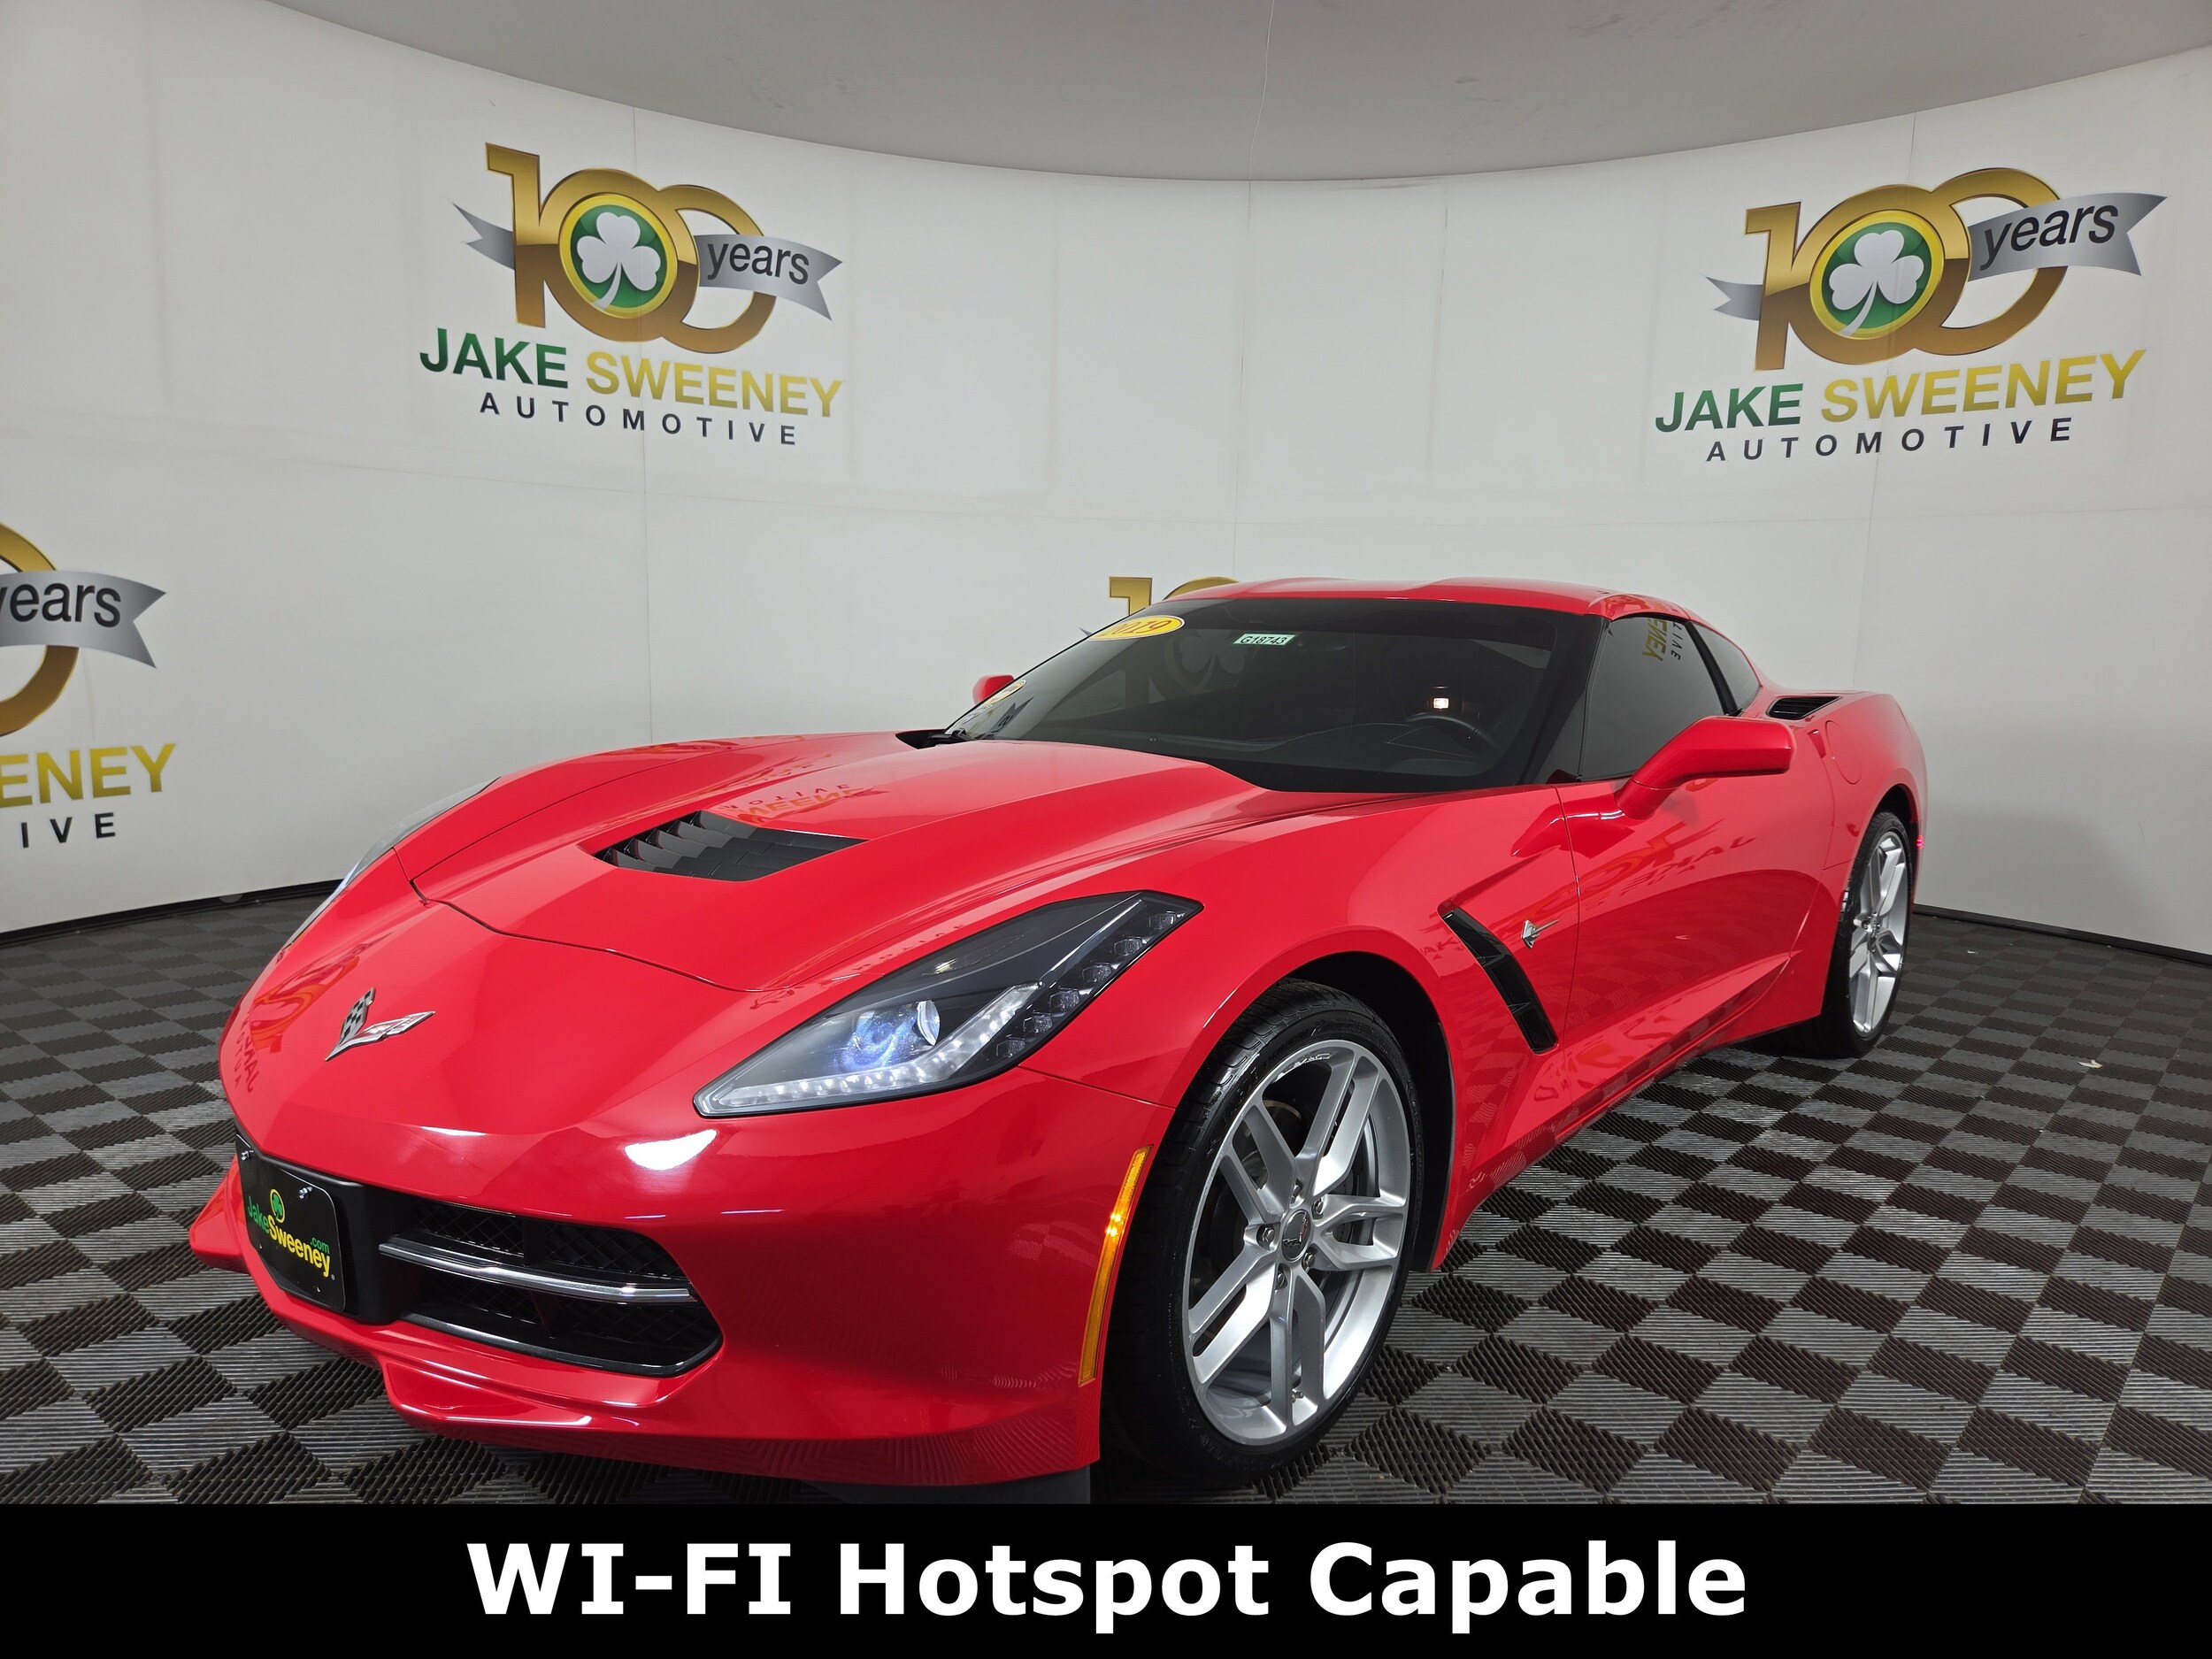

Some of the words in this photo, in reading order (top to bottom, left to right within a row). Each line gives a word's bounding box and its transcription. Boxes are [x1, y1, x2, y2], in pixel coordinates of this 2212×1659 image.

[486, 142, 777, 354] 100
[707, 242, 810, 285] years
[1979, 204, 2119, 271] years
[1745, 167, 2070, 371] 100
[419, 328, 568, 388] JAKE
[587, 351, 842, 418] SWEENEY
[1655, 382, 1803, 433] JAKE
[1822, 349, 2147, 423] SWEENEY
[480, 392, 797, 445] AUTOMOTIVE
[1706, 417, 2072, 462] AUTOMOTIVE
[0, 582, 122, 628] ears
[1240, 635, 1287, 645] G18743
